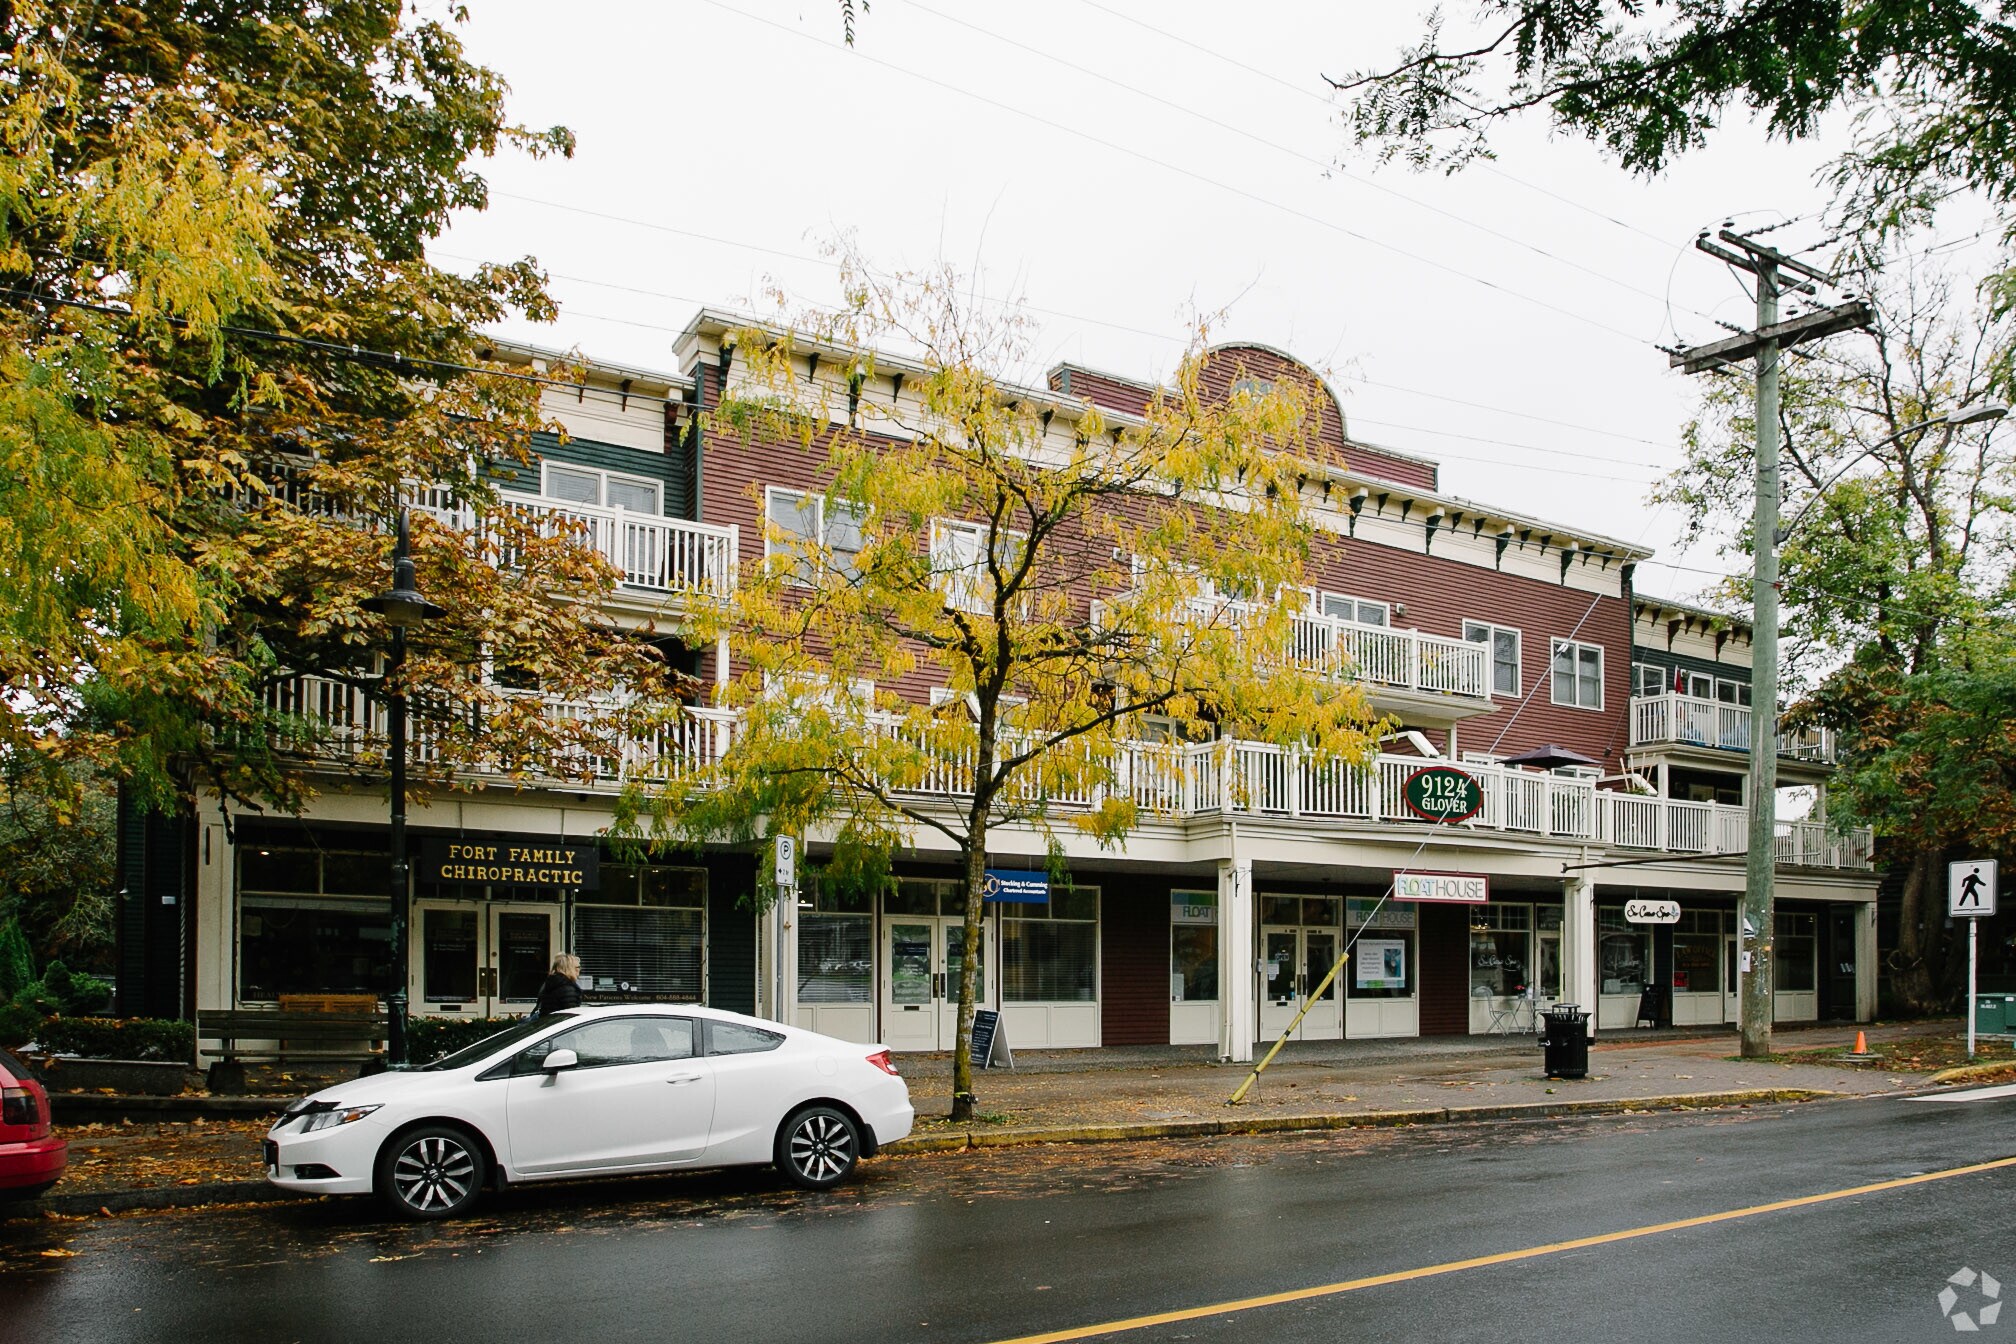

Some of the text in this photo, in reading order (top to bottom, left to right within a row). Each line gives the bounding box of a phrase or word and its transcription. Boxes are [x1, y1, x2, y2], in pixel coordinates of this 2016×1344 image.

[1421, 774, 1467, 798] 9124
[1421, 797, 1467, 813] GLOVER
[449, 845, 576, 864] FORT FAMILY
[441, 865, 583, 884] CHIROPRACTIC
[1397, 876, 1483, 898] FLOAT HOUSE
[1183, 906, 1210, 918] FLOAT
[1383, 913, 1413, 923] HOUSE
